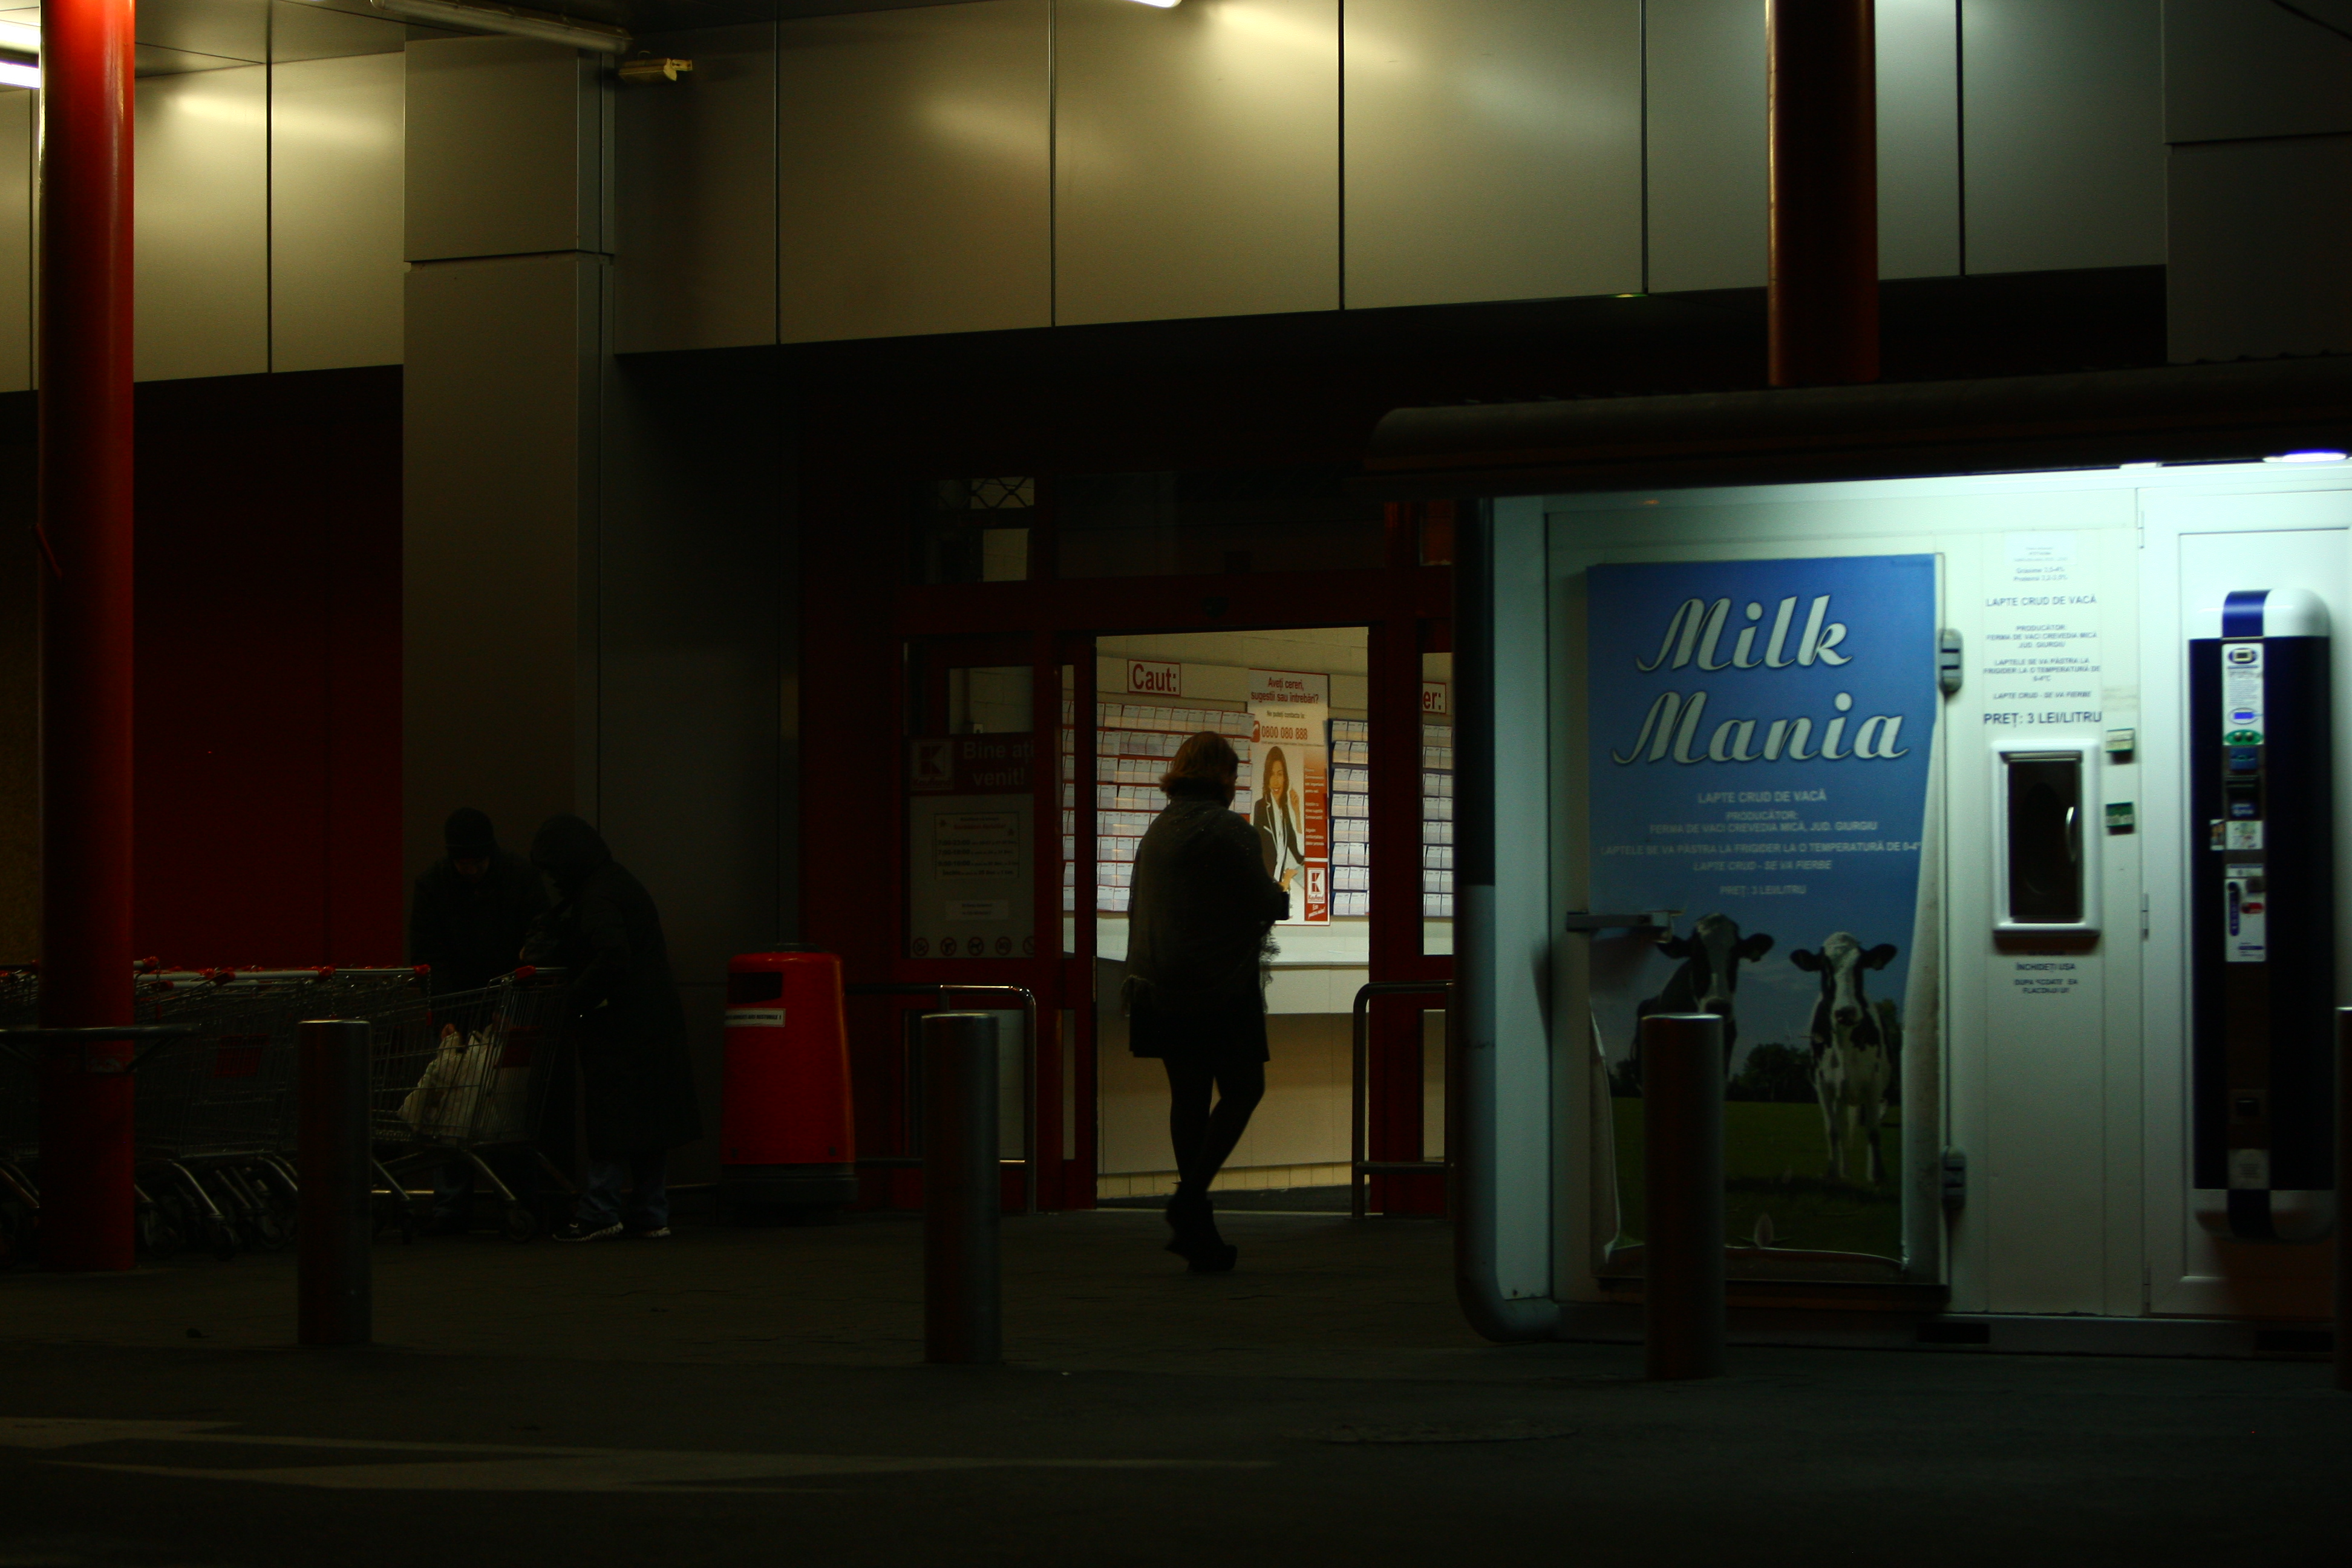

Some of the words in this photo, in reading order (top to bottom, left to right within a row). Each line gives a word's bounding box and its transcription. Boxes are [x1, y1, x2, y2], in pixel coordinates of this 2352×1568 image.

[1986, 596, 2018, 606] LAPTE
[2021, 596, 2050, 606] CRUD
[2053, 596, 2066, 604] DE
[2069, 593, 2097, 604] VACĂ
[1636, 595, 1853, 671] Milk
[1133, 664, 1176, 691] Caut:
[1277, 693, 1288, 702] sau
[1612, 691, 1910, 764] Mania
[1984, 712, 2023, 728] PREȚ:
[2027, 713, 2034, 724] 3
[2039, 711, 2102, 724] LEI/LITRU
[1261, 726, 1278, 739] 0800
[1281, 727, 1293, 739] 080
[1295, 728, 1307, 740] 888
[963, 741, 1006, 759] Bine
[973, 766, 1025, 787] venit!
[1697, 792, 1736, 804] LAPTE
[1739, 791, 1772, 803] CRUD
[1774, 791, 1791, 803] DE
[1793, 788, 1828, 803] VACĂ
[1685, 823, 1699, 834] DE
[1646, 844, 1659, 855] SE
[1662, 844, 1675, 854] VA
[1719, 844, 1732, 854] LA
[1783, 843, 1797, 852] LA
[1886, 841, 1901, 852] DE
